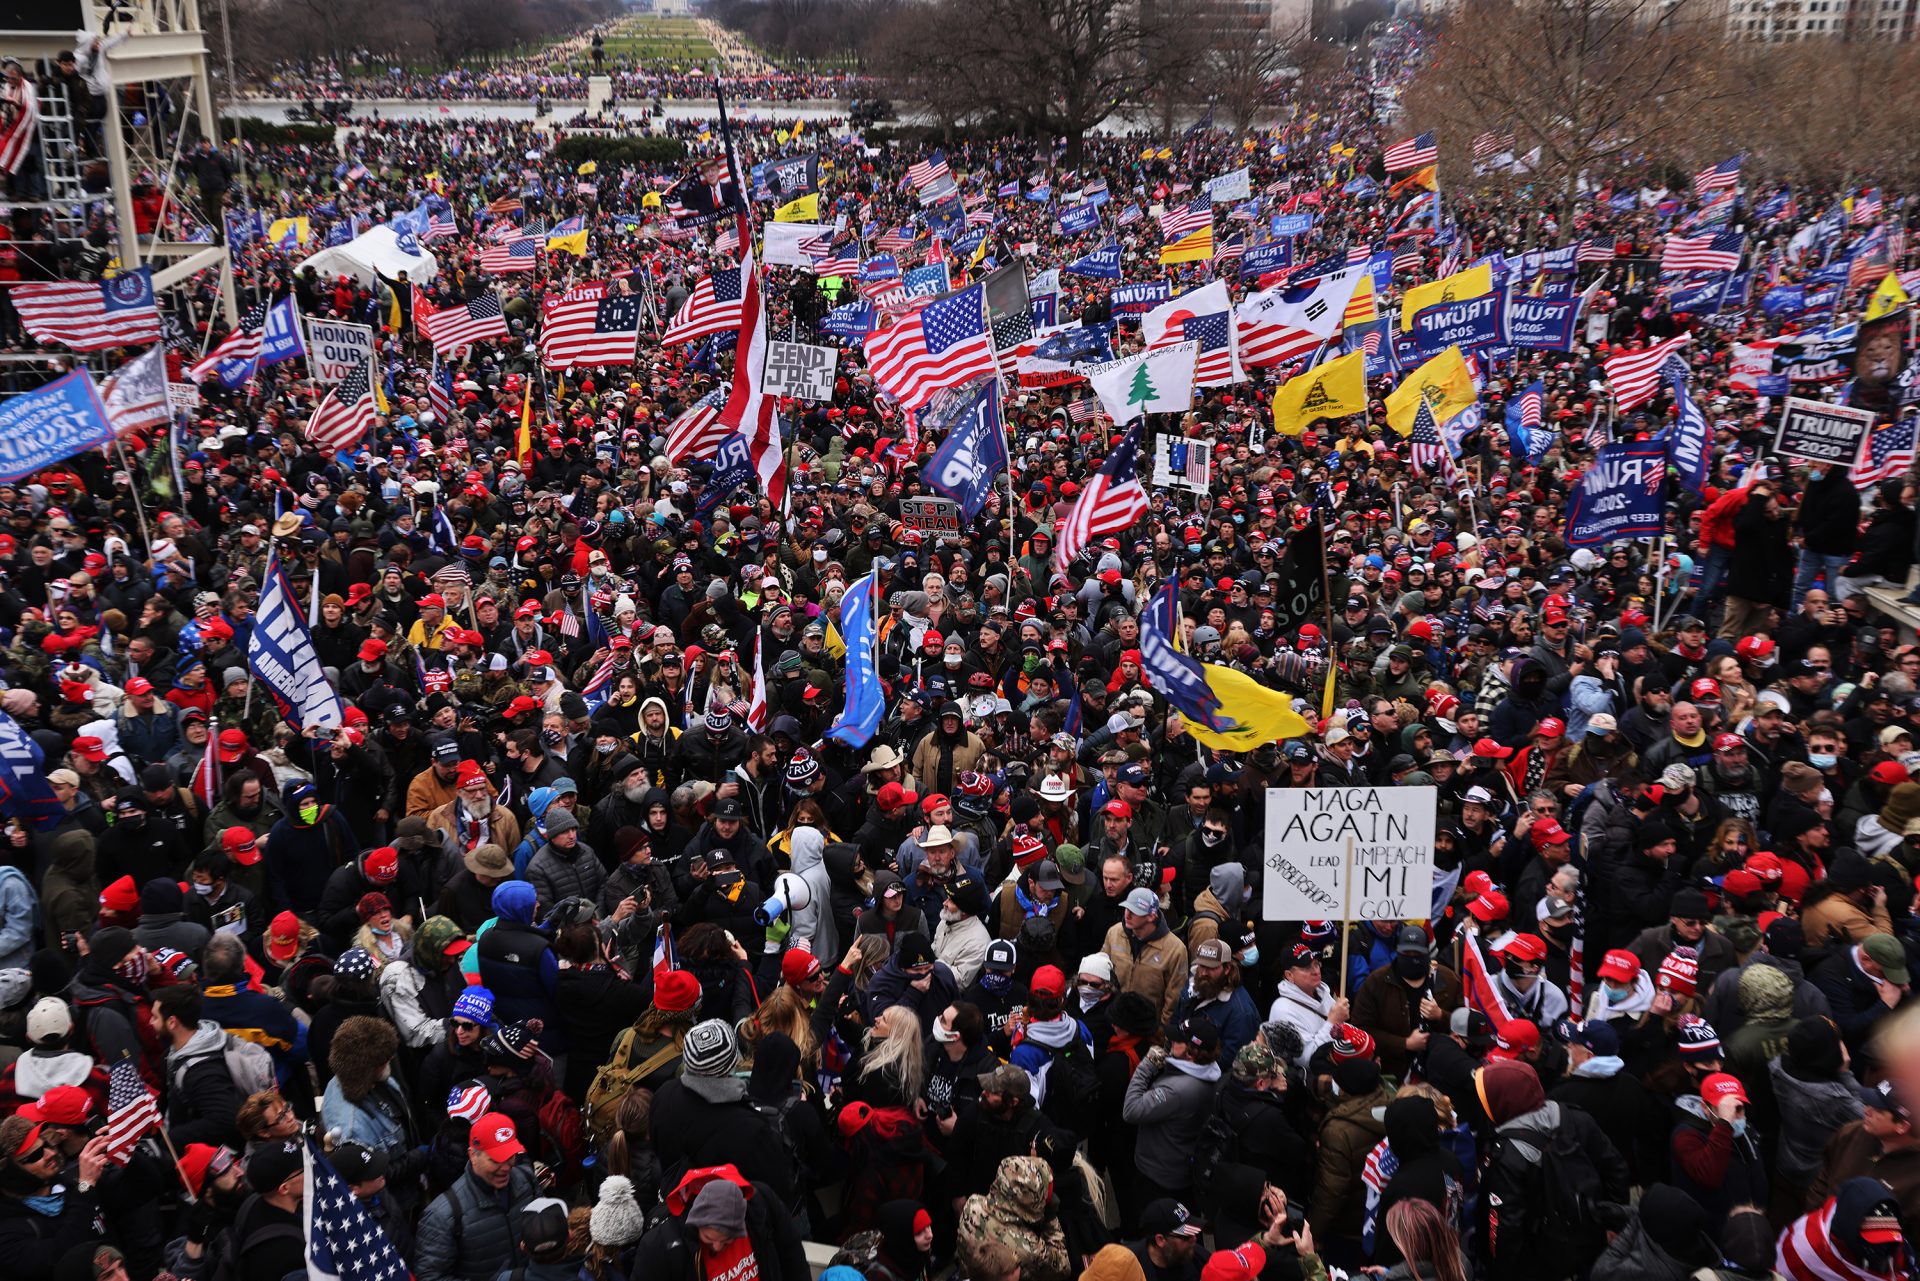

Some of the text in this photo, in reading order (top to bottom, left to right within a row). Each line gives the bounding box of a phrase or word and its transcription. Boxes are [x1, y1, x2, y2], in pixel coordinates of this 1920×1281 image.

[313, 325, 367, 345] HONOR
[323, 345, 362, 362] OUR
[772, 342, 825, 369] SEND
[319, 363, 356, 379] VOT
[766, 364, 812, 386] JOE
[169, 384, 195, 393] STOP
[782, 382, 821, 399] JAIL
[170, 397, 196, 406] STEAL
[1791, 413, 1863, 440] TRUMP
[1796, 440, 1842, 457] 2020
[904, 517, 956, 530] STEAL
[1303, 788, 1383, 811] MAGA
[1280, 813, 1409, 842] AGAIN
[1310, 855, 1340, 867] LEAD
[1354, 846, 1426, 866] IMPEACH
[1364, 866, 1408, 897] MI
[1360, 900, 1405, 919] GOV.
[457, 993, 491, 1012] Trump
